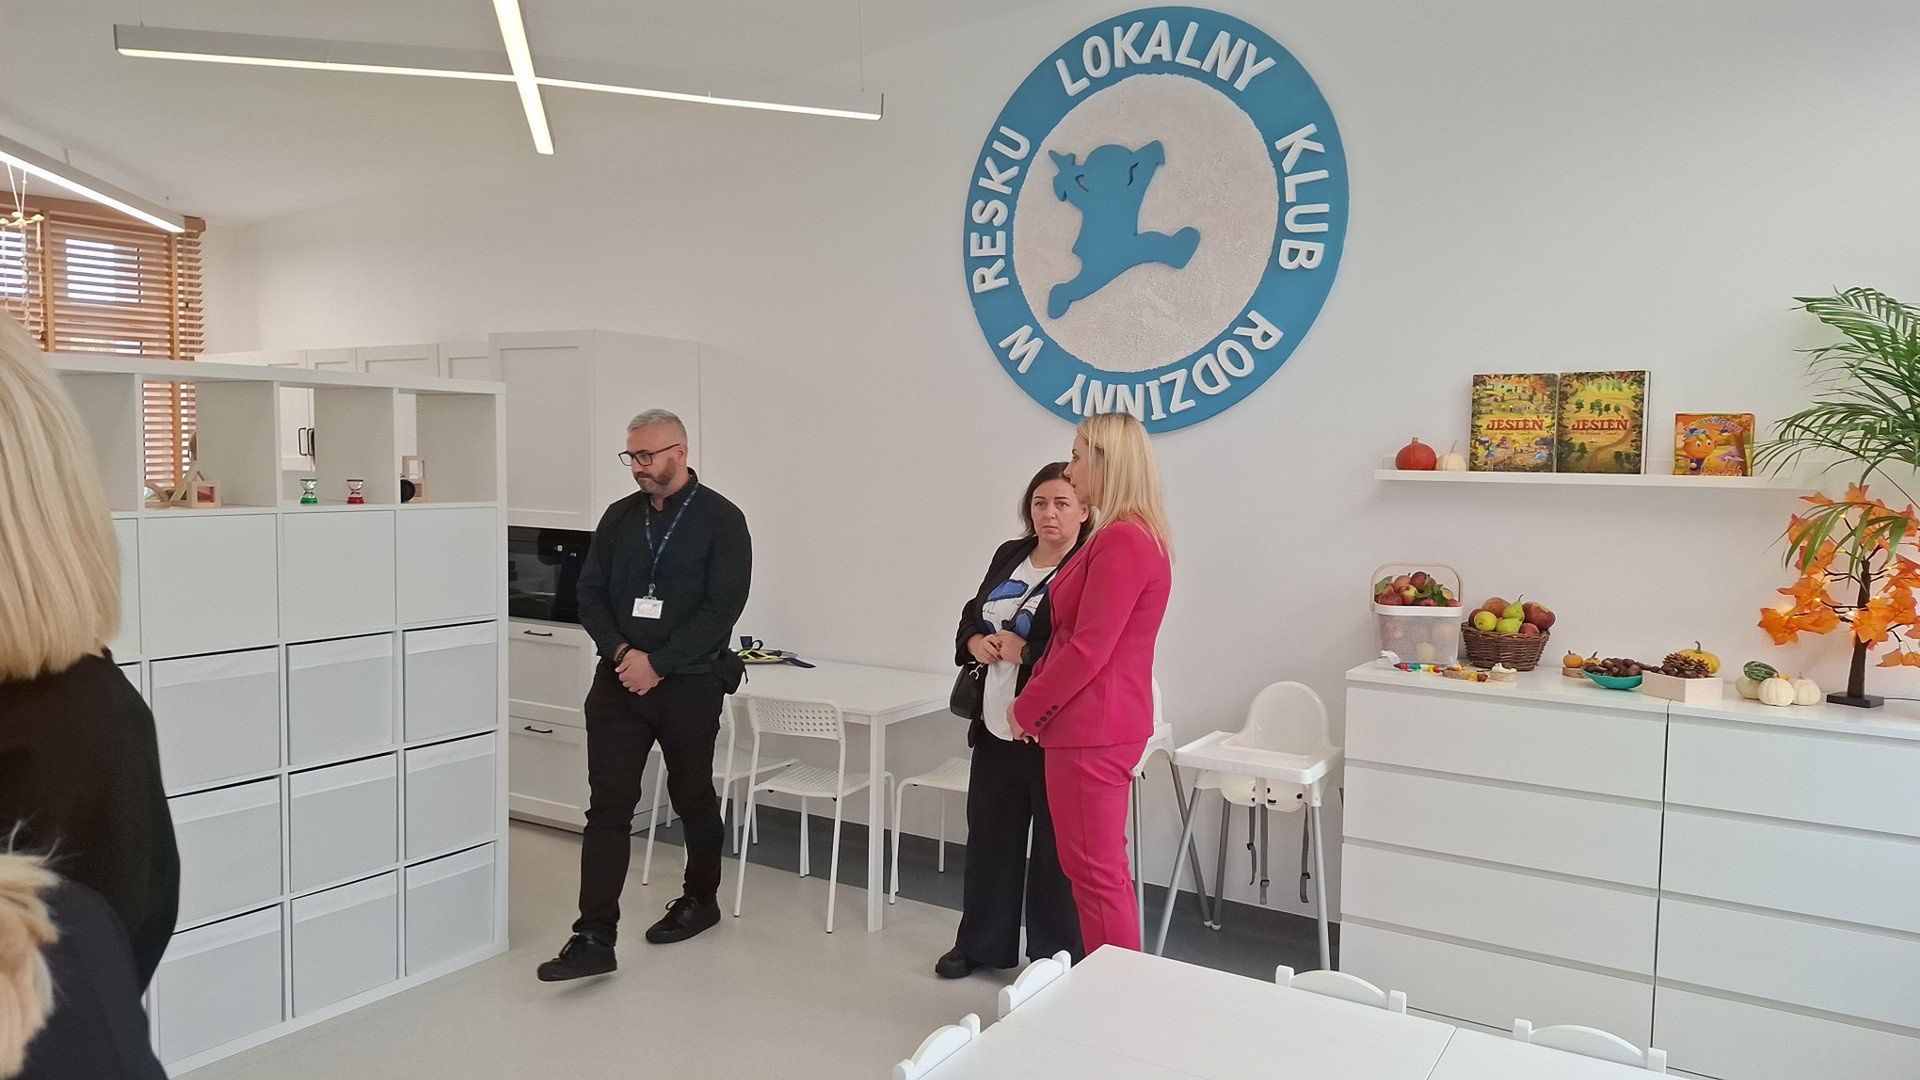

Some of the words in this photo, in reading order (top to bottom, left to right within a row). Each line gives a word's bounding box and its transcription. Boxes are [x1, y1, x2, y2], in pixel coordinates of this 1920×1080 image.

[1056, 20, 1277, 96] LOKALNY
[969, 125, 1031, 293] RESKU
[1274, 123, 1330, 271] KLUB
[998, 324, 1044, 374] W
[1054, 310, 1284, 421] RODZINNY
